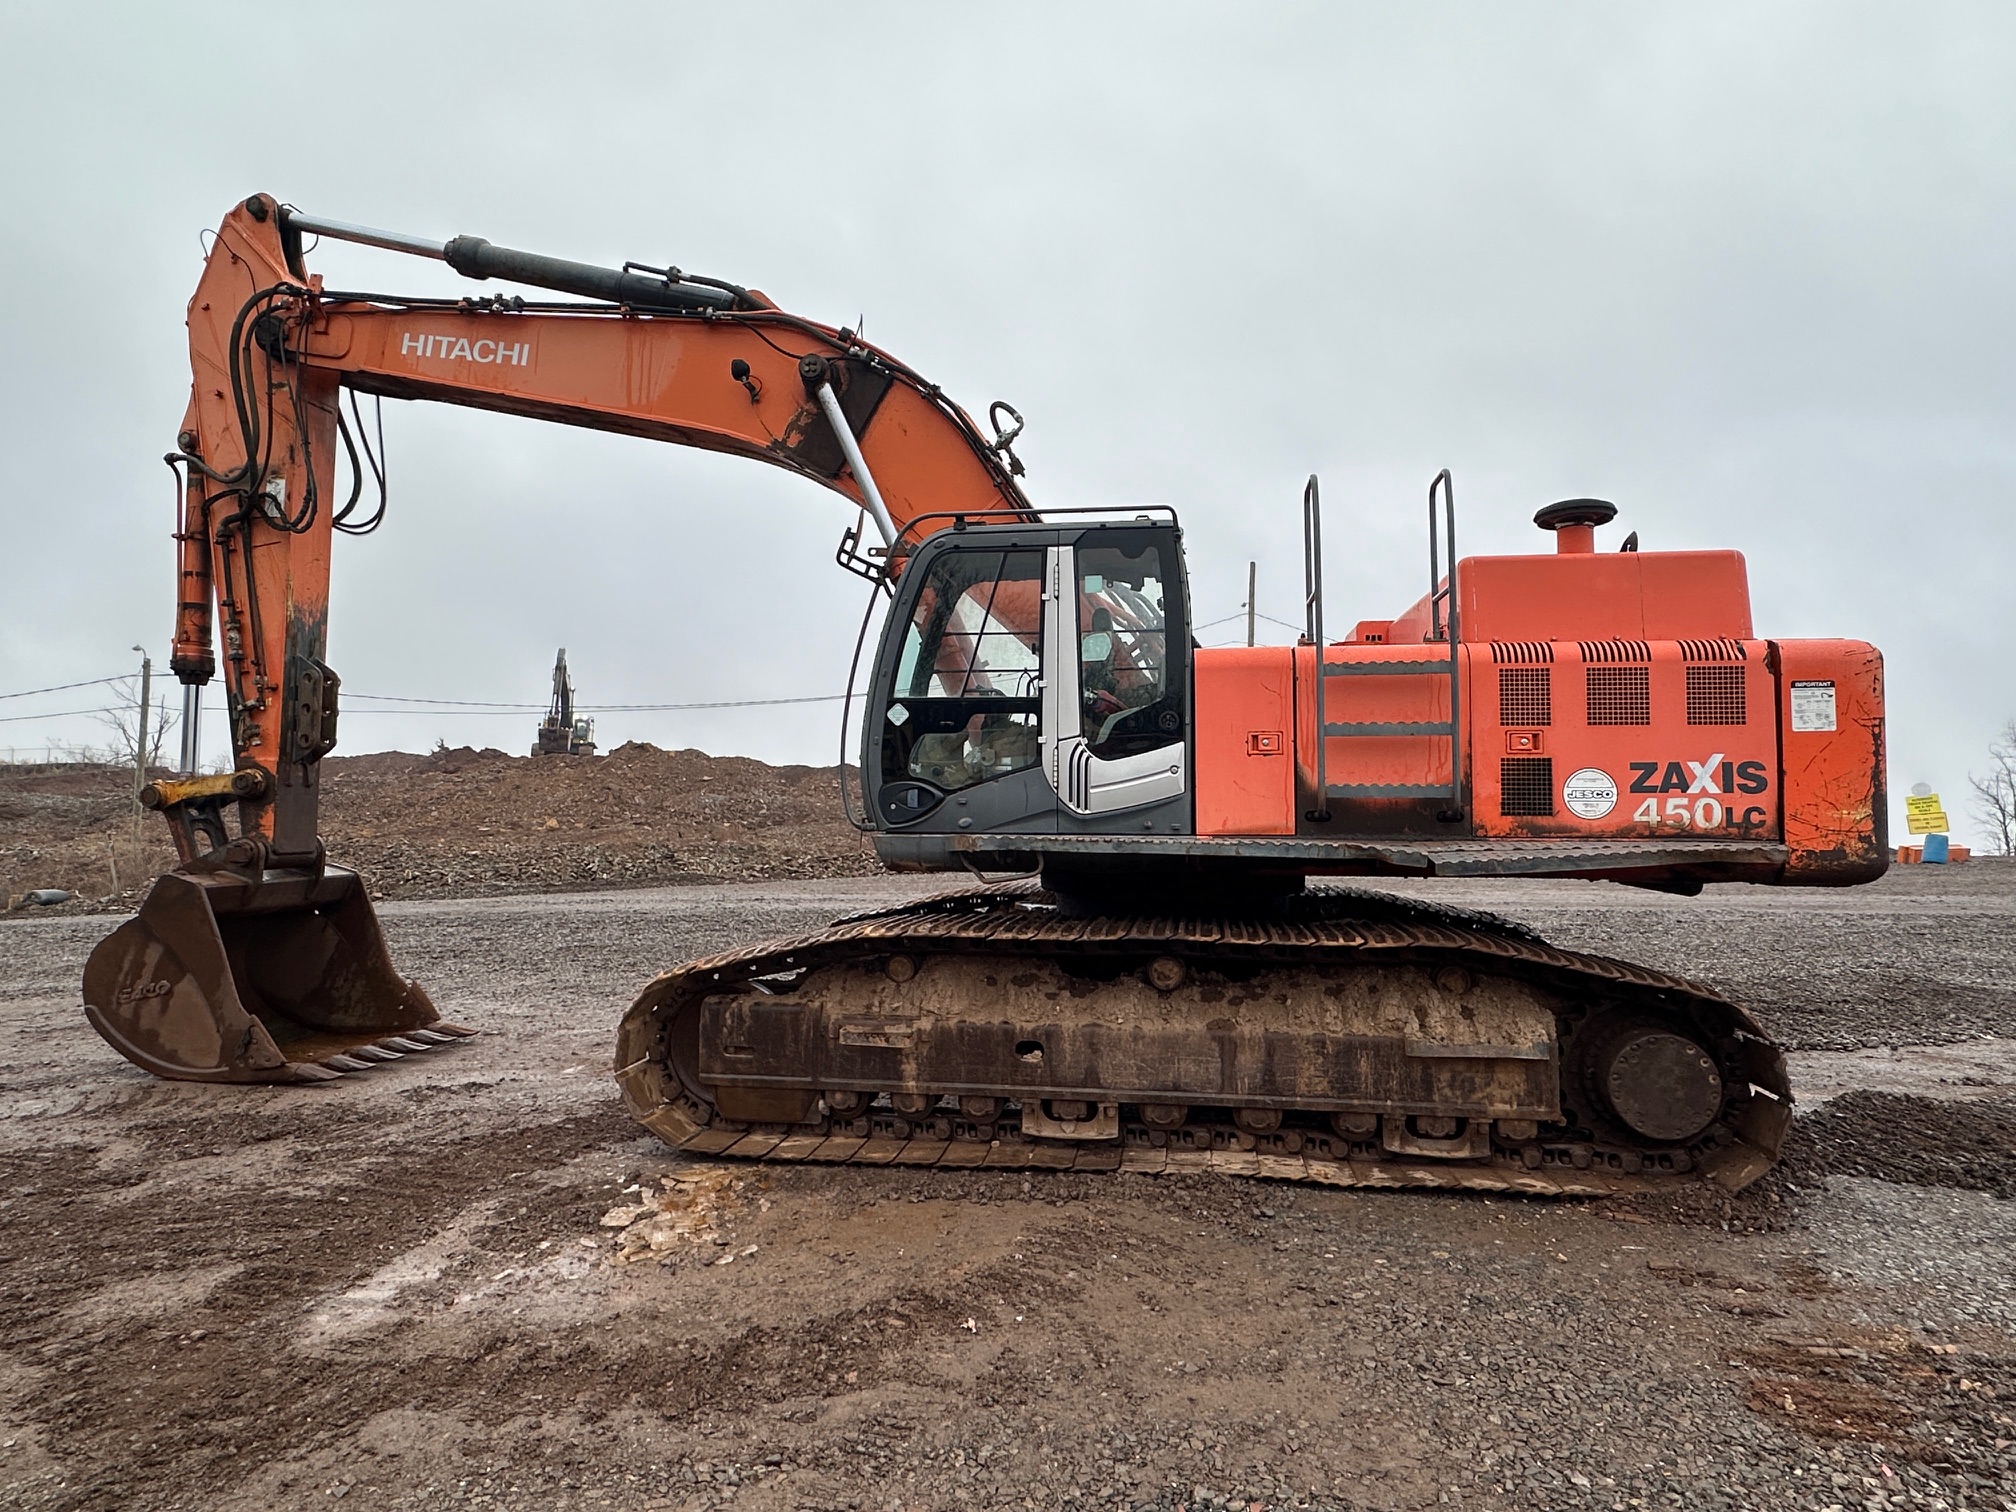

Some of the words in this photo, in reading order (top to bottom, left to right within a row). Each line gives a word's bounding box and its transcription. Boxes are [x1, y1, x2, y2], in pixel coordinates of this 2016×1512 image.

[401, 332, 530, 366] HITACHI
[1629, 753, 1768, 794] ZAXIS
[1567, 789, 1613, 799] JESCO
